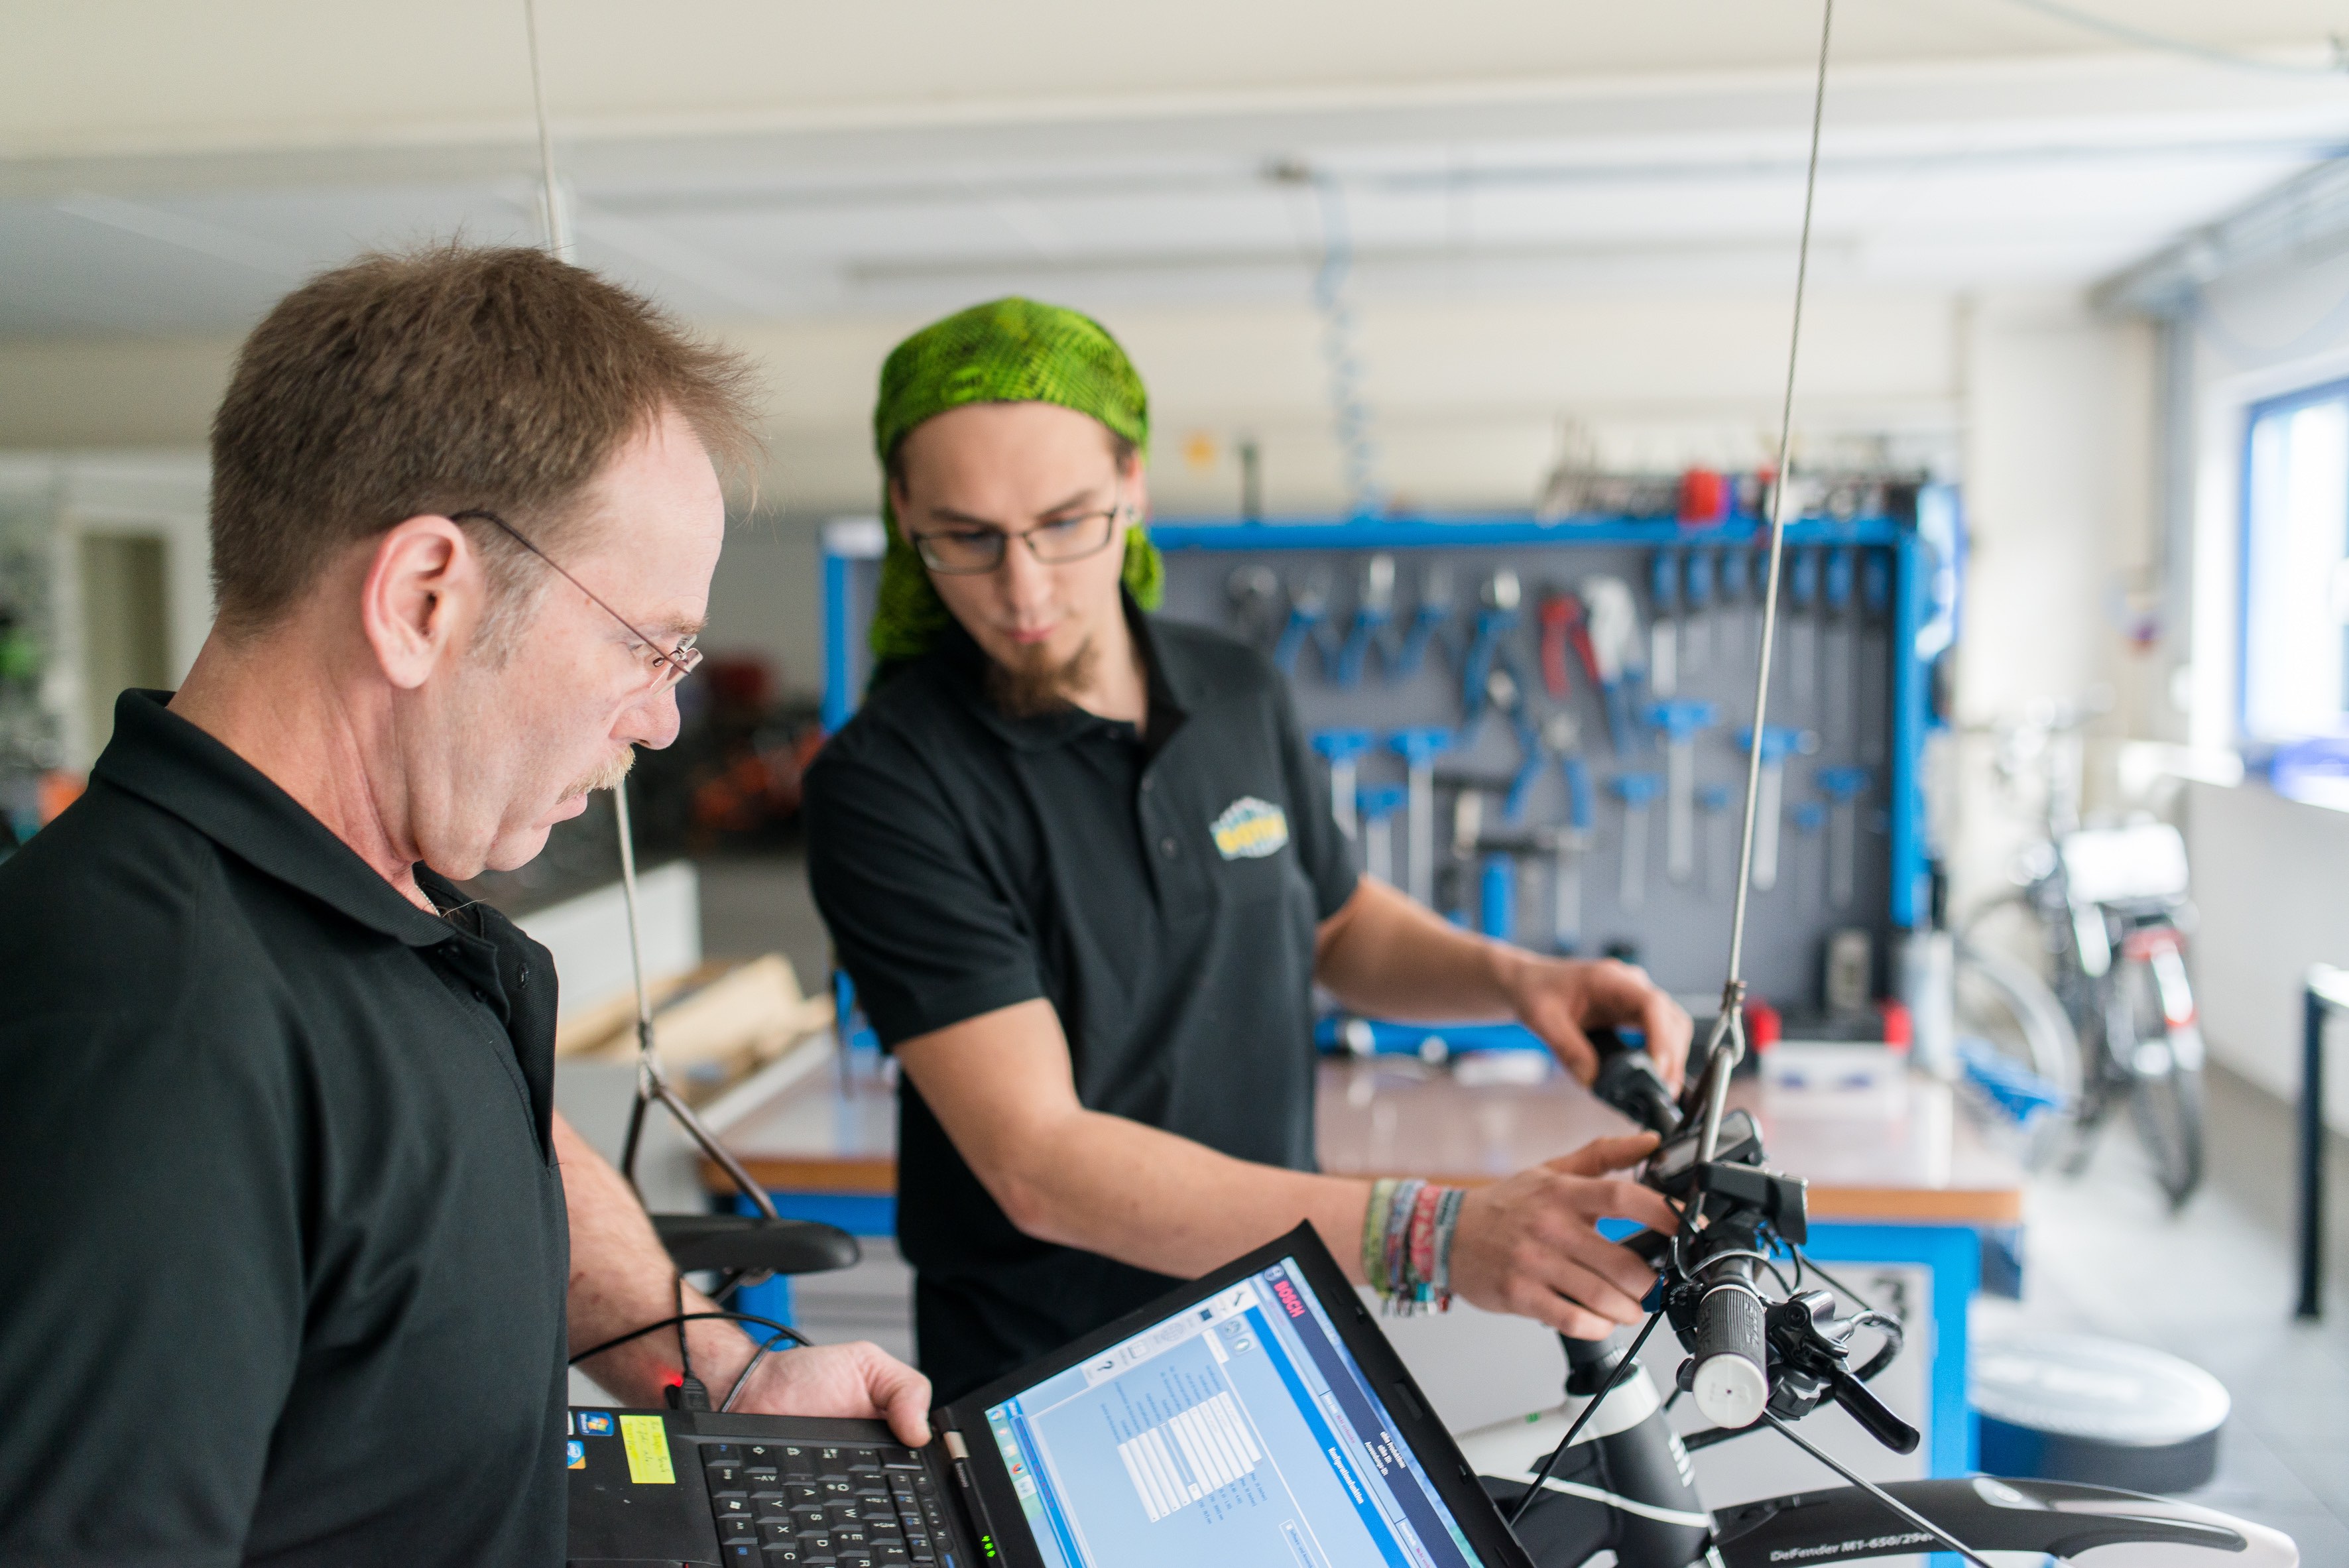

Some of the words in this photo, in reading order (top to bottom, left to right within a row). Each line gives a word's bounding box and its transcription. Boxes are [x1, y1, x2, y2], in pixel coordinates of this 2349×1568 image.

[1273, 1280, 1305, 1318] BOSCH
[837, 1483, 849, 1492] Q
[1327, 1447, 1364, 1504] Konfigurationsfunktion
[845, 1508, 857, 1518] W
